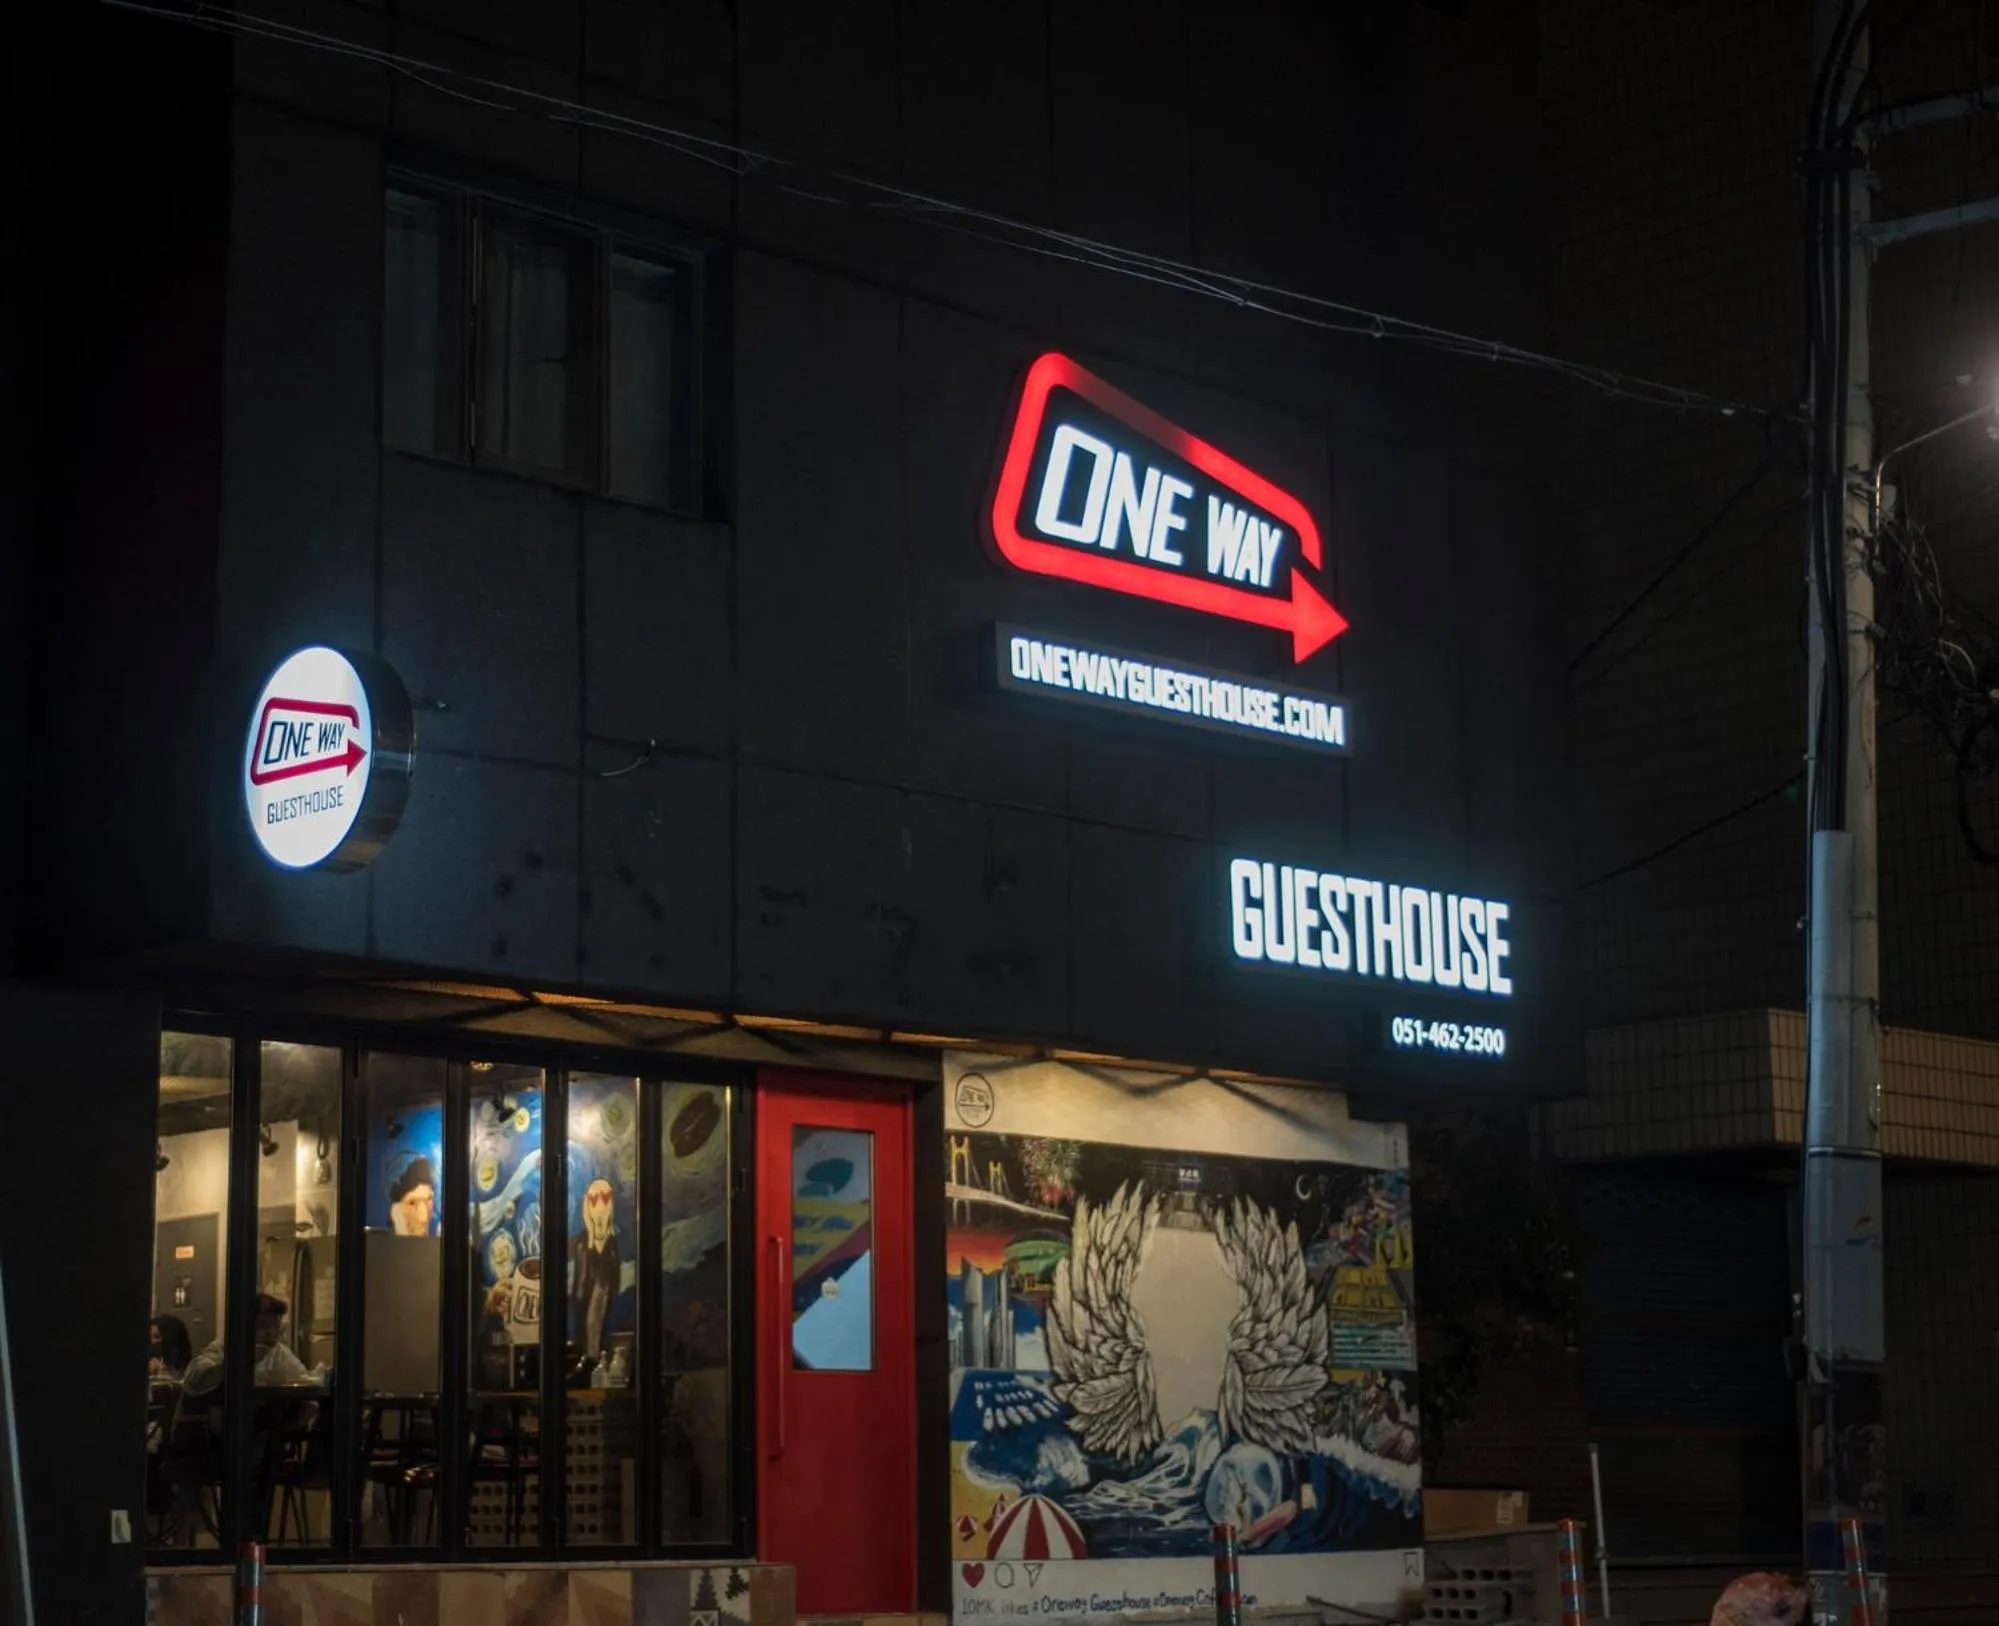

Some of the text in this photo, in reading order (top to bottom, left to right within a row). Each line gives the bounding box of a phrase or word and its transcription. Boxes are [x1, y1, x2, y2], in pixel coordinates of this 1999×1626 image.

[1035, 423, 1283, 588] ONE WAY
[1010, 636, 1346, 746] ONEWAYGUESTHOUSE.COM
[264, 721, 345, 764] ONE WAY
[266, 785, 344, 824] GUESTHOUSE
[1230, 858, 1513, 995] GUESTHOUSE
[1392, 1016, 1506, 1055] 051-462-2500
